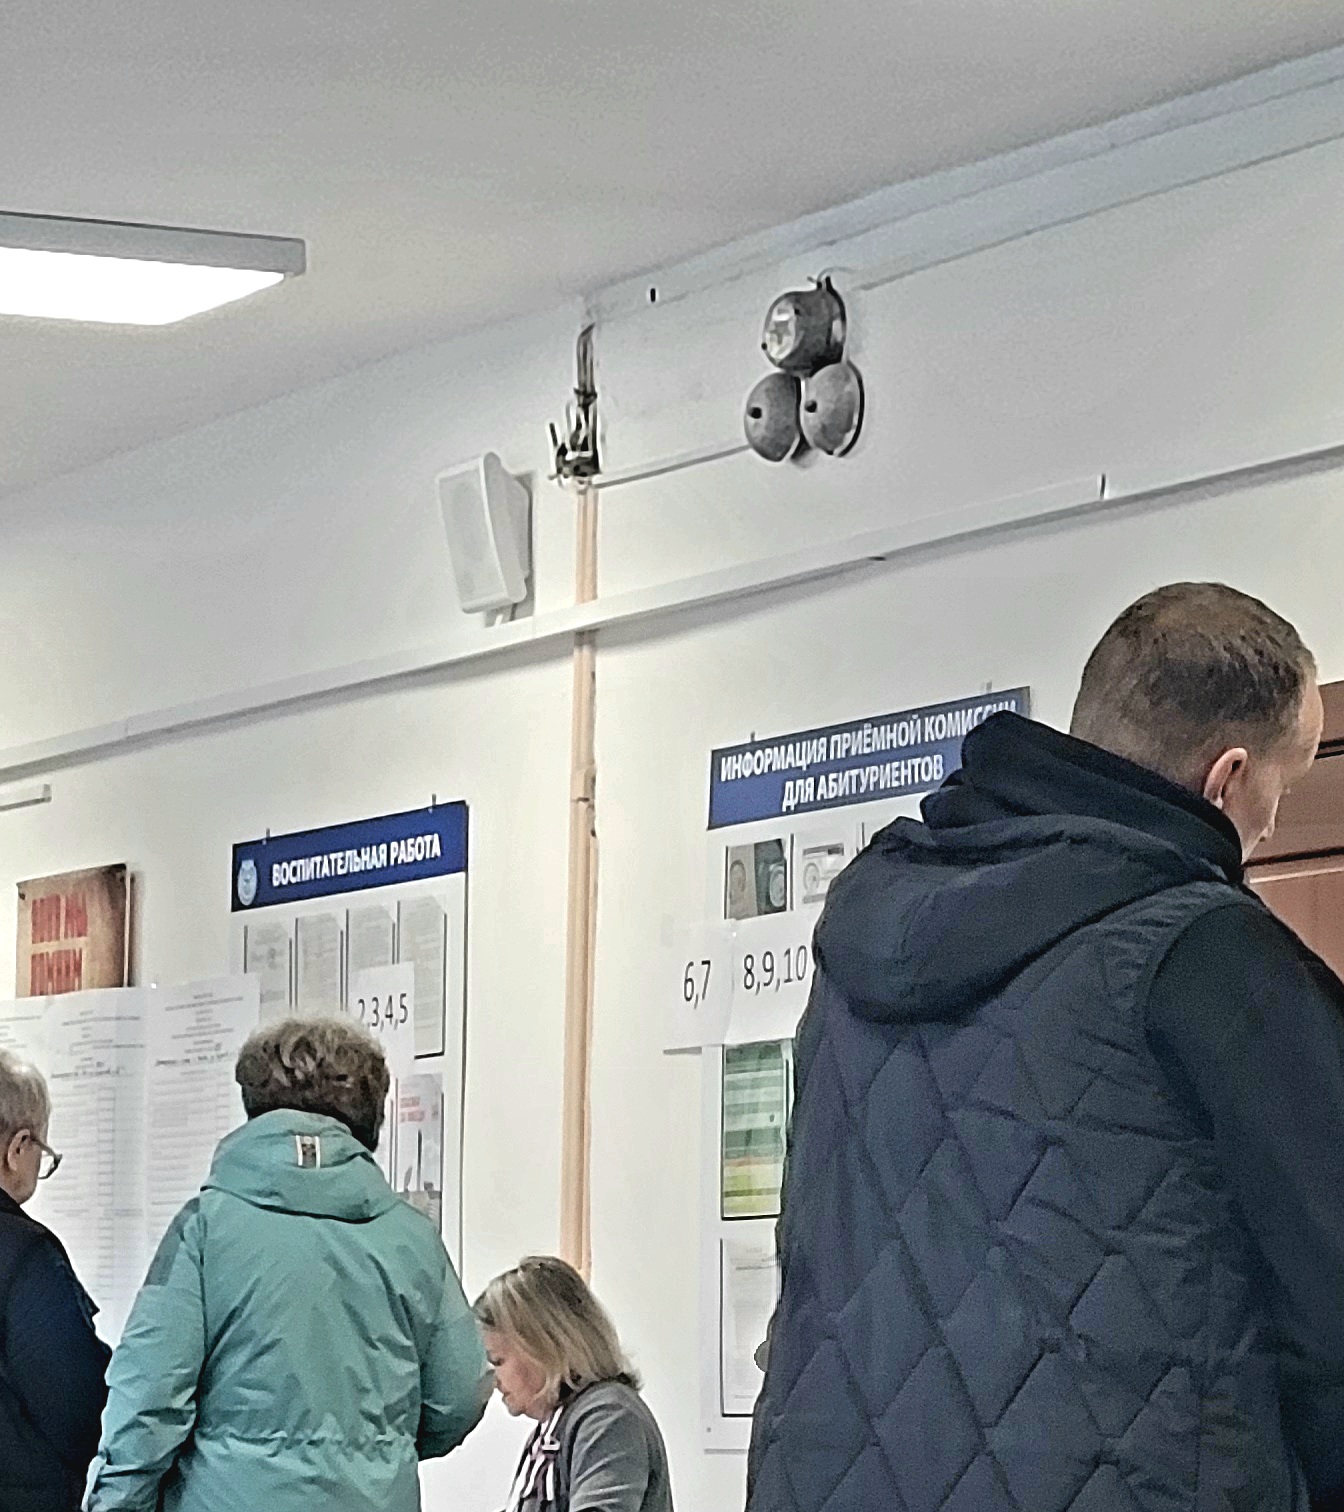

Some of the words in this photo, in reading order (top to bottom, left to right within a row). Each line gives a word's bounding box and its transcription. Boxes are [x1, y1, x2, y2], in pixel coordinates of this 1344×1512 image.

[720, 730, 828, 782] ИНФОРМАЦИЯ
[829, 713, 922, 760] ПРИЁМНОЙ
[781, 779, 815, 813] ДЛЯ
[816, 753, 945, 801] АБИТУРИЕНТОВ
[272, 843, 388, 887] ВОСПИТАТЕЛЬНАЯ
[389, 832, 442, 866] РАБОТА
[683, 960, 712, 1010] 6,7
[743, 944, 808, 996] 8,9,10
